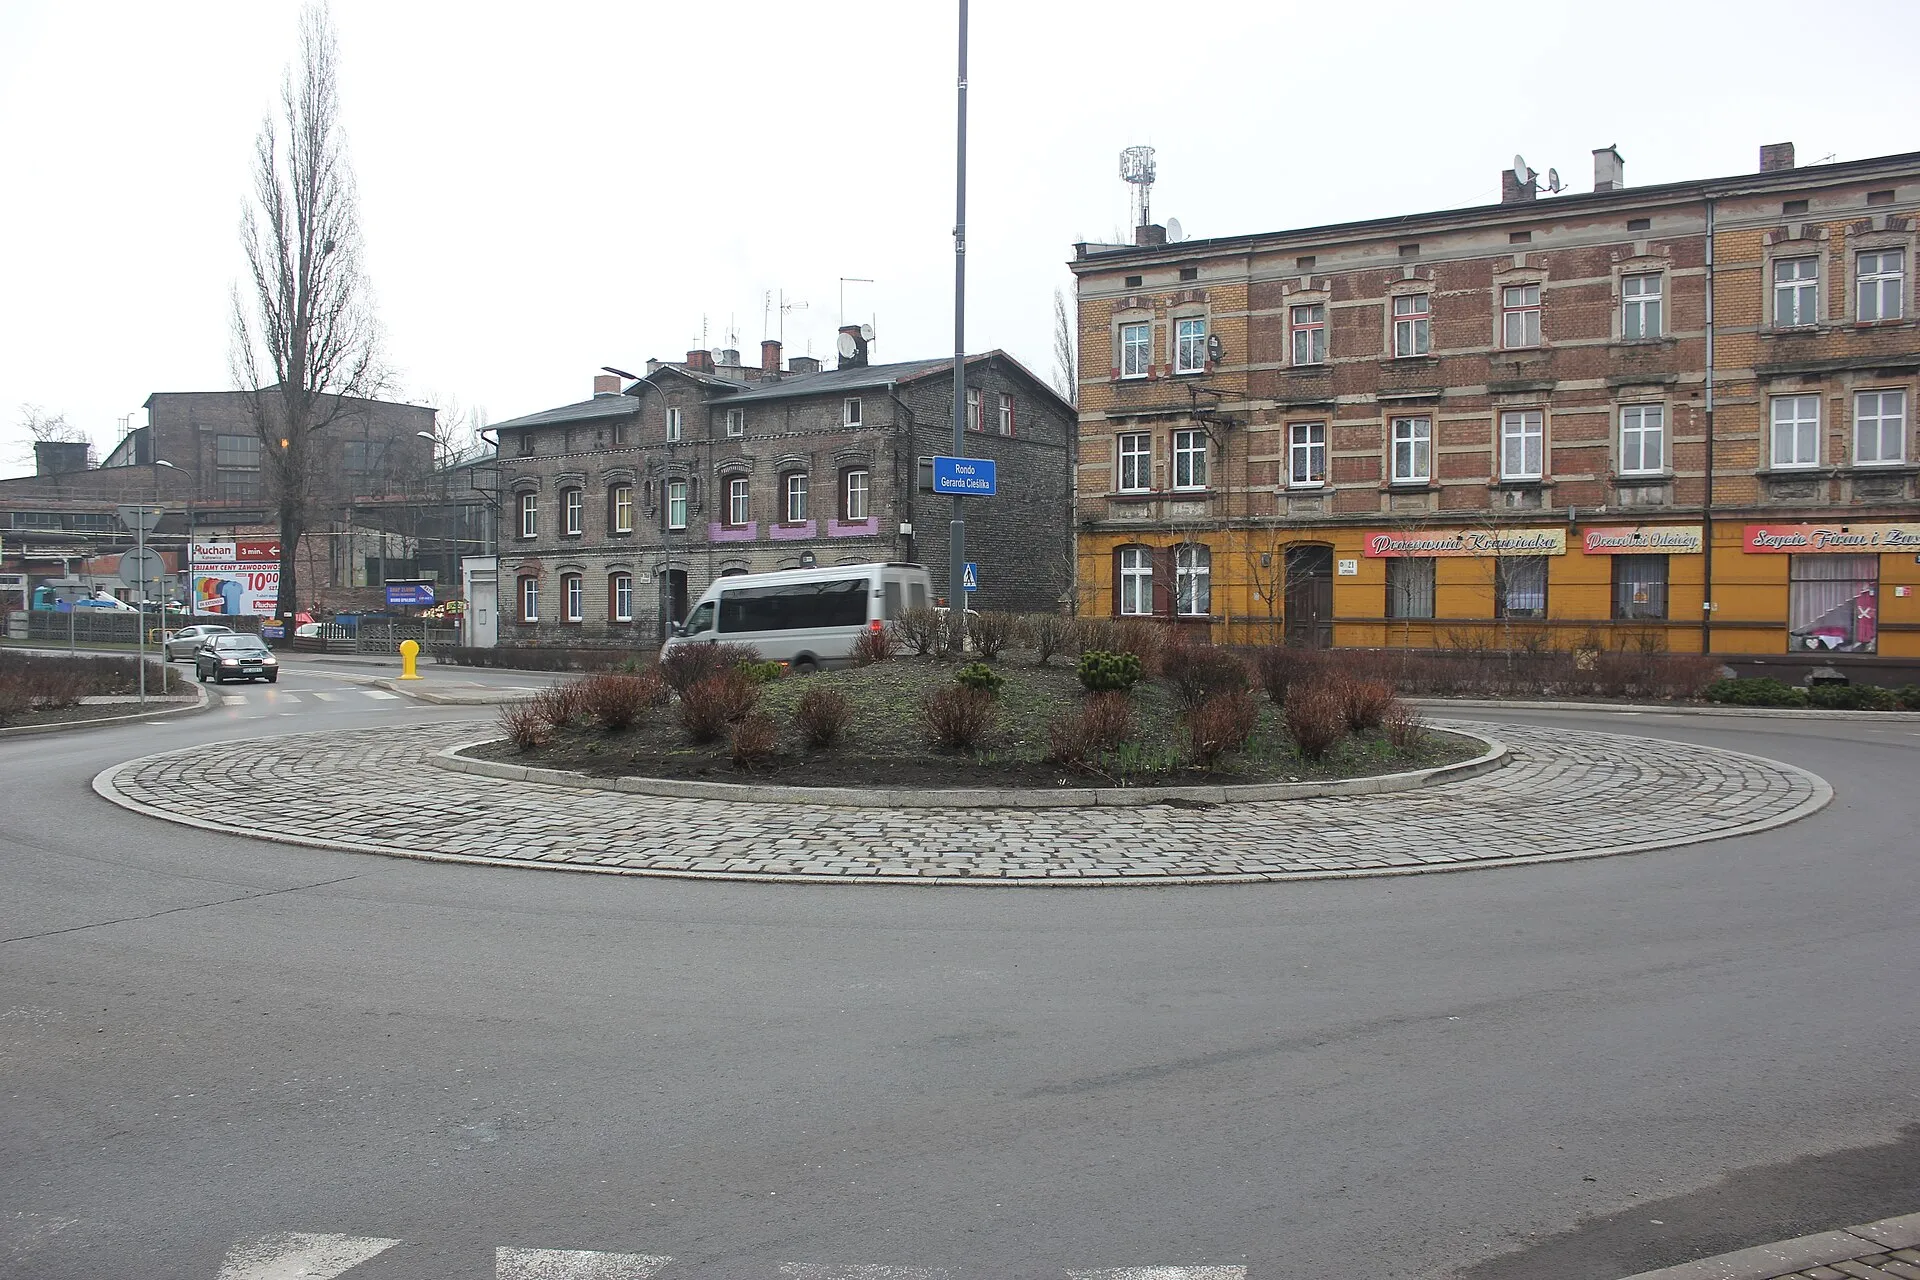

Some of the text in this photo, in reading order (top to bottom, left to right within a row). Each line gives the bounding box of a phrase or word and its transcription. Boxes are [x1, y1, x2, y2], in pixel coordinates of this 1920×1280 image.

[955, 463, 976, 475] Rondo
[941, 476, 990, 489] Gerarda Cieślika
[1371, 533, 1558, 555] Pracownia Krawiecka
[1650, 532, 1699, 550] Odzieży
[1752, 530, 1807, 549] Szycie
[1809, 529, 1867, 549] Firan
[1868, 531, 1879, 546] i
[193, 545, 231, 555] Auchan
